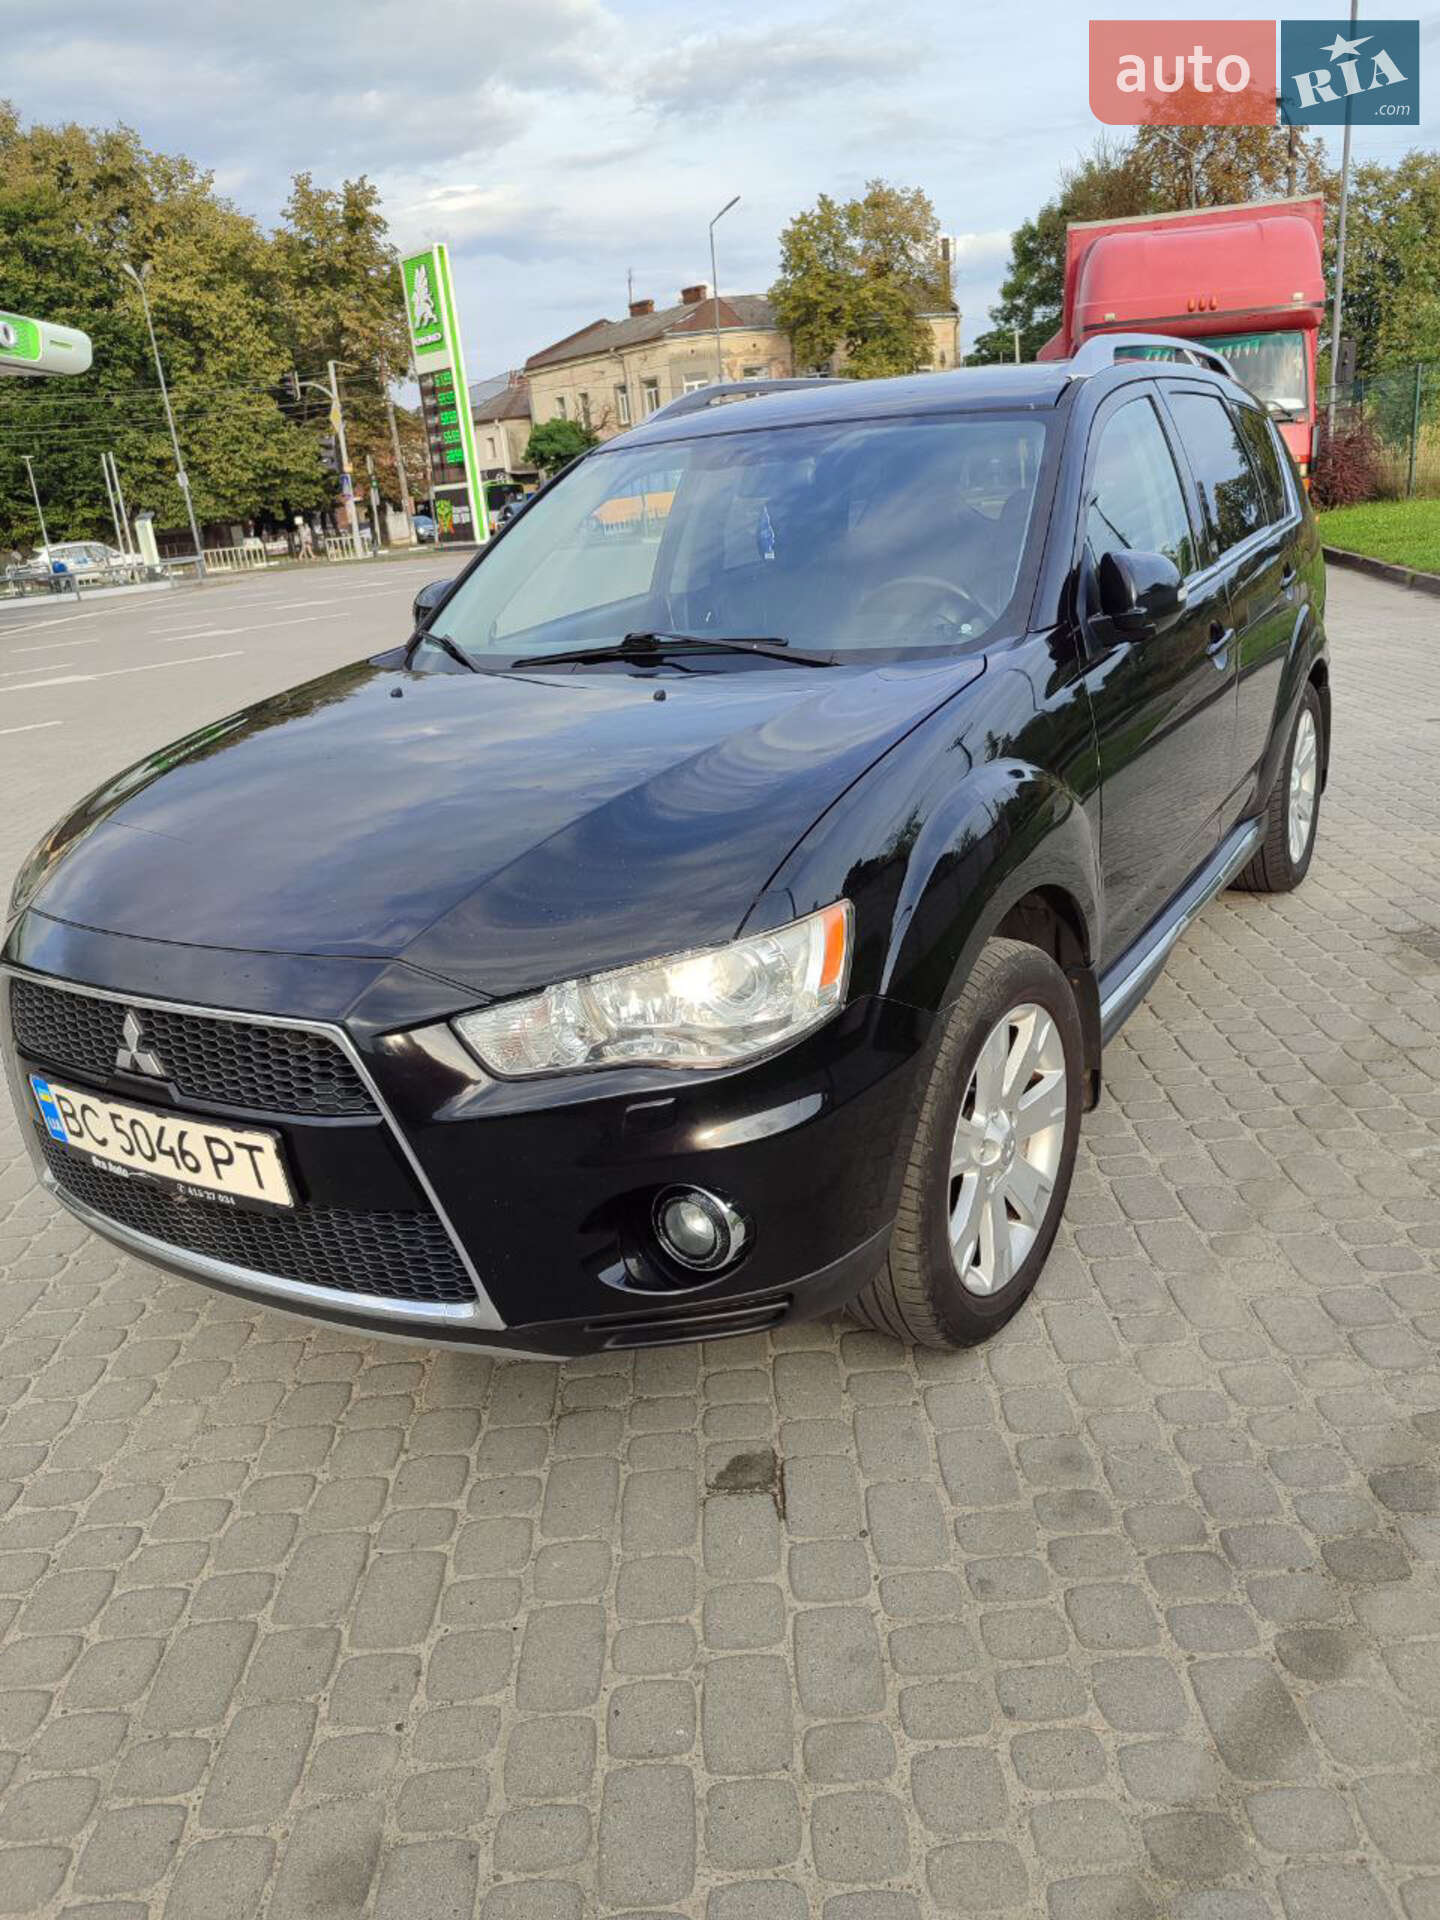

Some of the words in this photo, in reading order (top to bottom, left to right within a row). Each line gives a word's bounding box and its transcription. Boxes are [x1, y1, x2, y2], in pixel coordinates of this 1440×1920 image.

[55, 1094, 109, 1147] BC
[109, 1111, 201, 1174] 5046
[204, 1135, 265, 1190] PT
